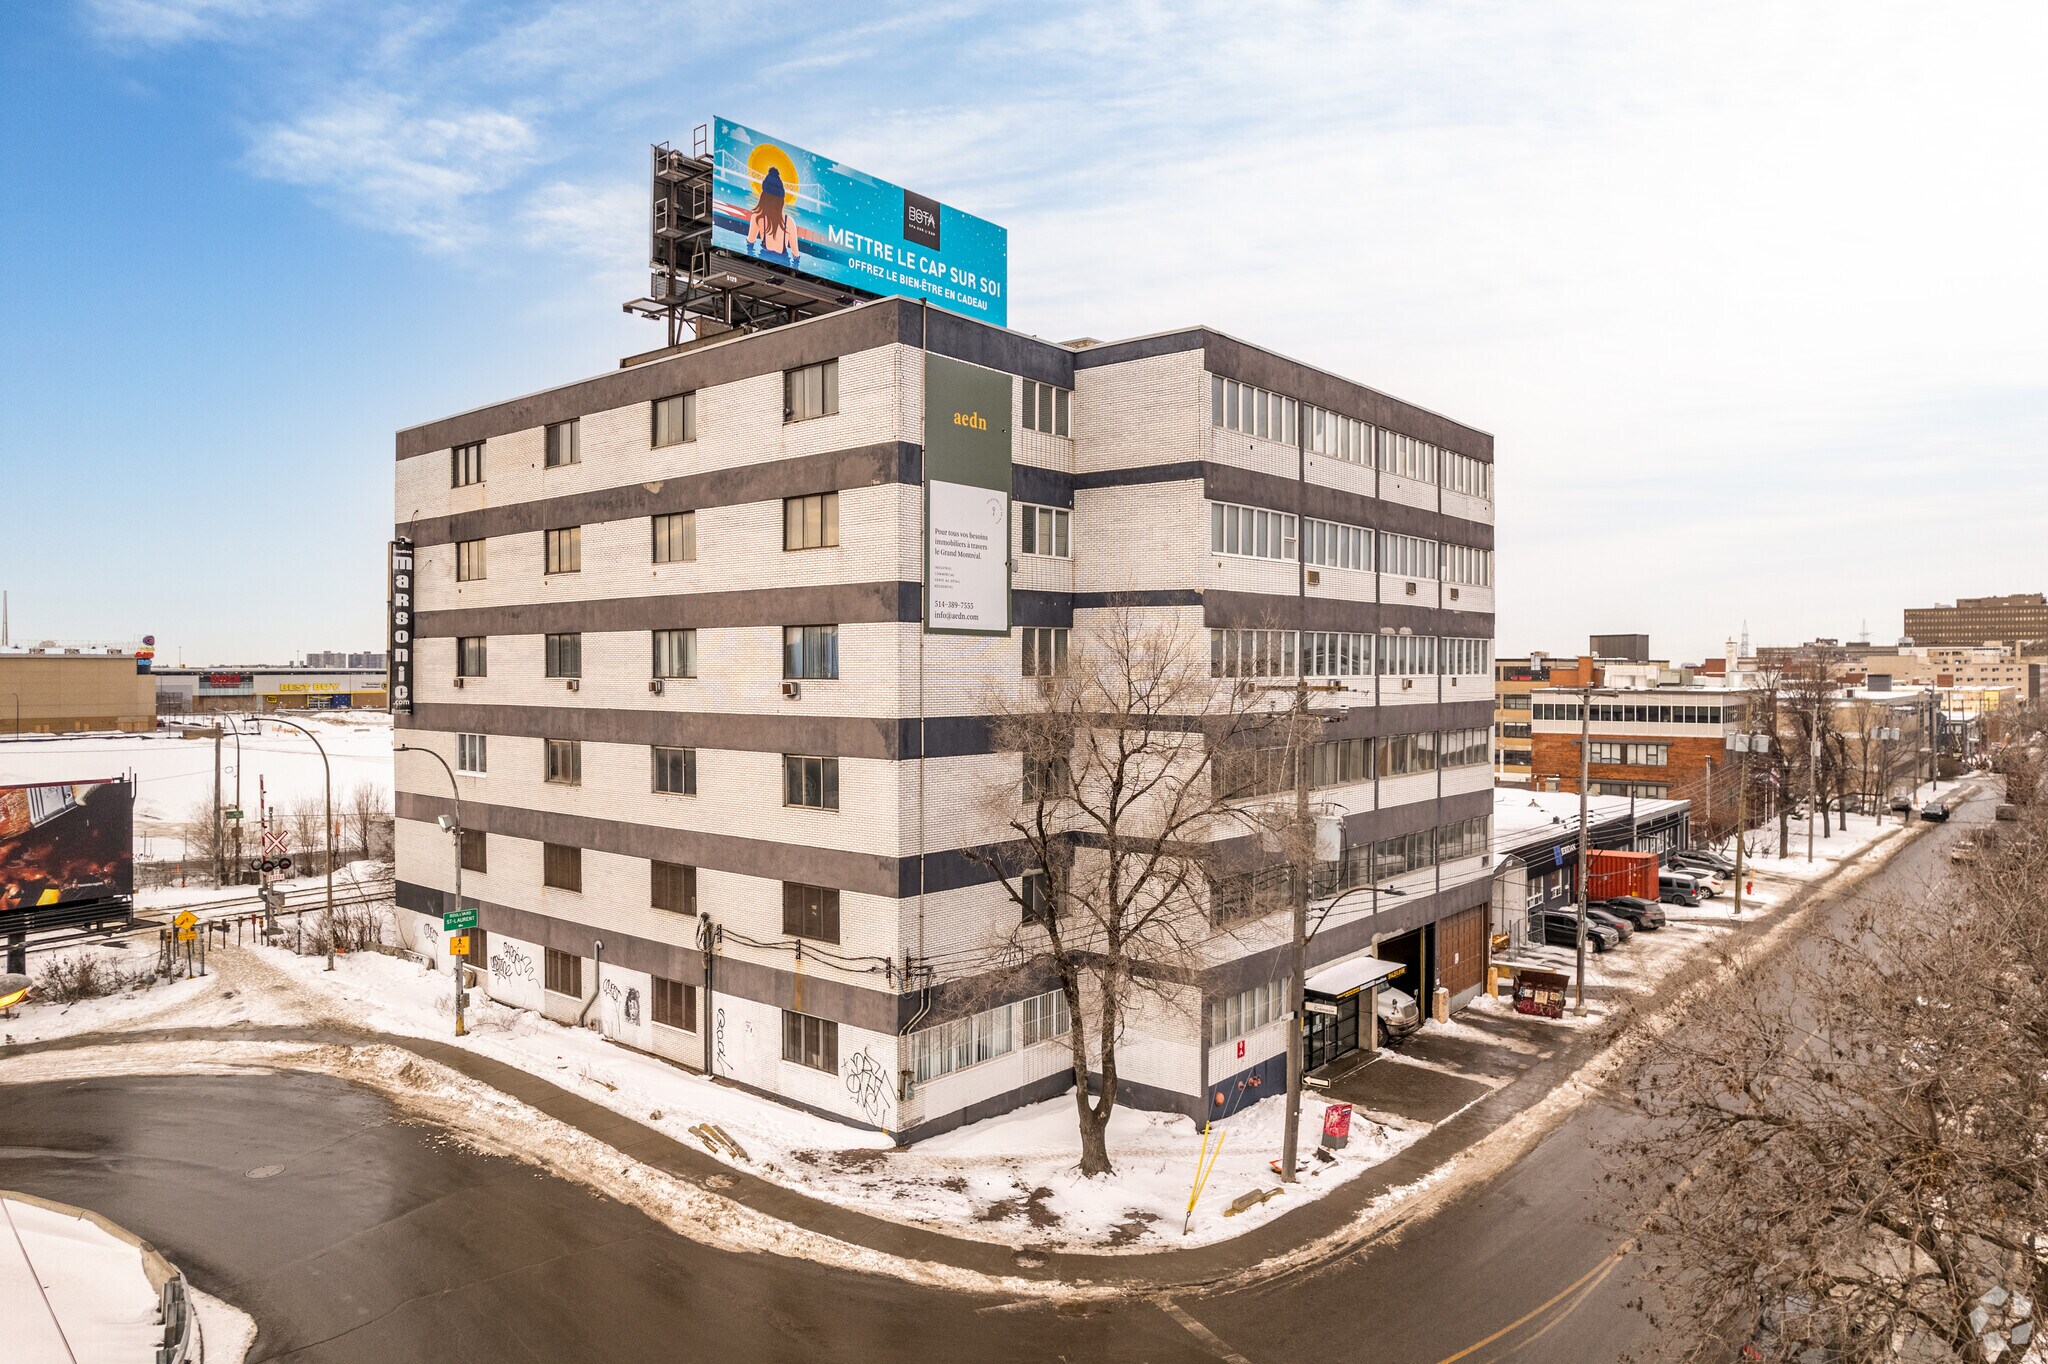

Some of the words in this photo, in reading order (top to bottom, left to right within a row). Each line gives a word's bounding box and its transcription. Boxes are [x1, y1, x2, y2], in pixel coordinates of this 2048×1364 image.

[909, 205, 936, 229] BOTA
[828, 224, 894, 263] METTRE
[897, 248, 916, 270] LE
[919, 256, 947, 278] CAP
[950, 266, 977, 290] SUR
[980, 276, 1001, 298] SOI
[848, 257, 885, 278] OFFREZ
[886, 269, 898, 282] LE
[900, 273, 943, 296] BIEN-ÊTRE
[945, 288, 956, 300] EN
[957, 292, 988, 311] CADEAU
[953, 411, 987, 431] aedn
[969, 531, 989, 541] besoins
[935, 538, 966, 548] immobiliers
[940, 548, 957, 557] Grand
[934, 611, 979, 621] info@aedn.com
[280, 683, 310, 691] BEST
[313, 683, 340, 691] BUY
[446, 915, 475, 925] ST-LAURENT
